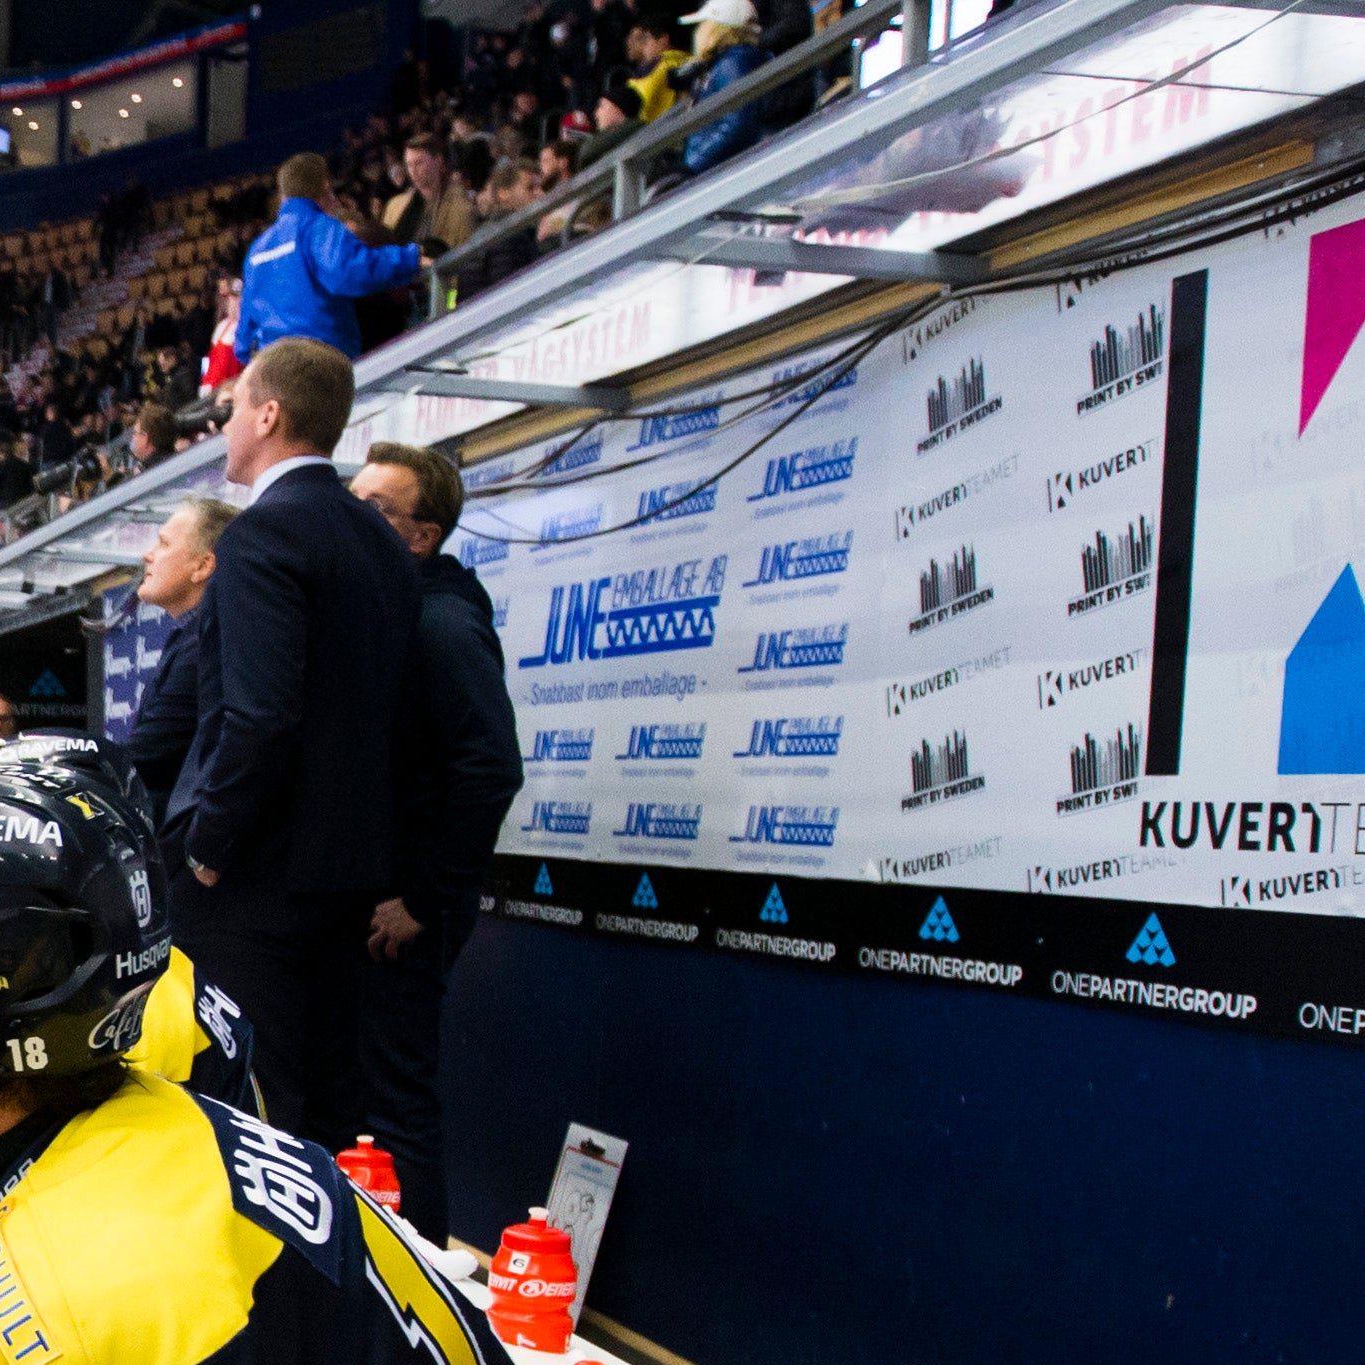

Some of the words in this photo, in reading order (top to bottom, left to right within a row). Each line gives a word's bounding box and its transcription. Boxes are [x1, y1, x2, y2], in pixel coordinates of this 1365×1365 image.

[1077, 385, 1114, 415] PRINT
[1116, 376, 1133, 395] BY
[917, 431, 945, 454] PRINT
[945, 423, 958, 438] BY
[959, 397, 1003, 430] SWEDEN
[518, 577, 611, 669] JUNE
[613, 559, 702, 609] EMBALLAGE
[701, 554, 728, 594] AB
[909, 612, 936, 634] PRINT
[937, 606, 950, 622] BY
[951, 587, 995, 616] SWEDEN
[1068, 590, 1104, 616] PRINT
[1106, 583, 1124, 602] BY
[901, 792, 930, 813] PRINT
[930, 788, 942, 803] BY
[944, 775, 985, 798] SWEDEN
[1057, 792, 1093, 815] PRINT
[1094, 786, 1112, 805] BY
[504, 900, 583, 926] ONEPARTNERGROUP
[595, 912, 699, 943] ONEPARTNERGROUP
[715, 927, 837, 963] ONEPARTNERGROUP
[858, 947, 1023, 987] ONEPARTNERGROUP
[1052, 968, 1258, 1019] ONEPARTNERGROUP
[7, 1036, 49, 1072] 18
[513, 1257, 526, 1268] 6
